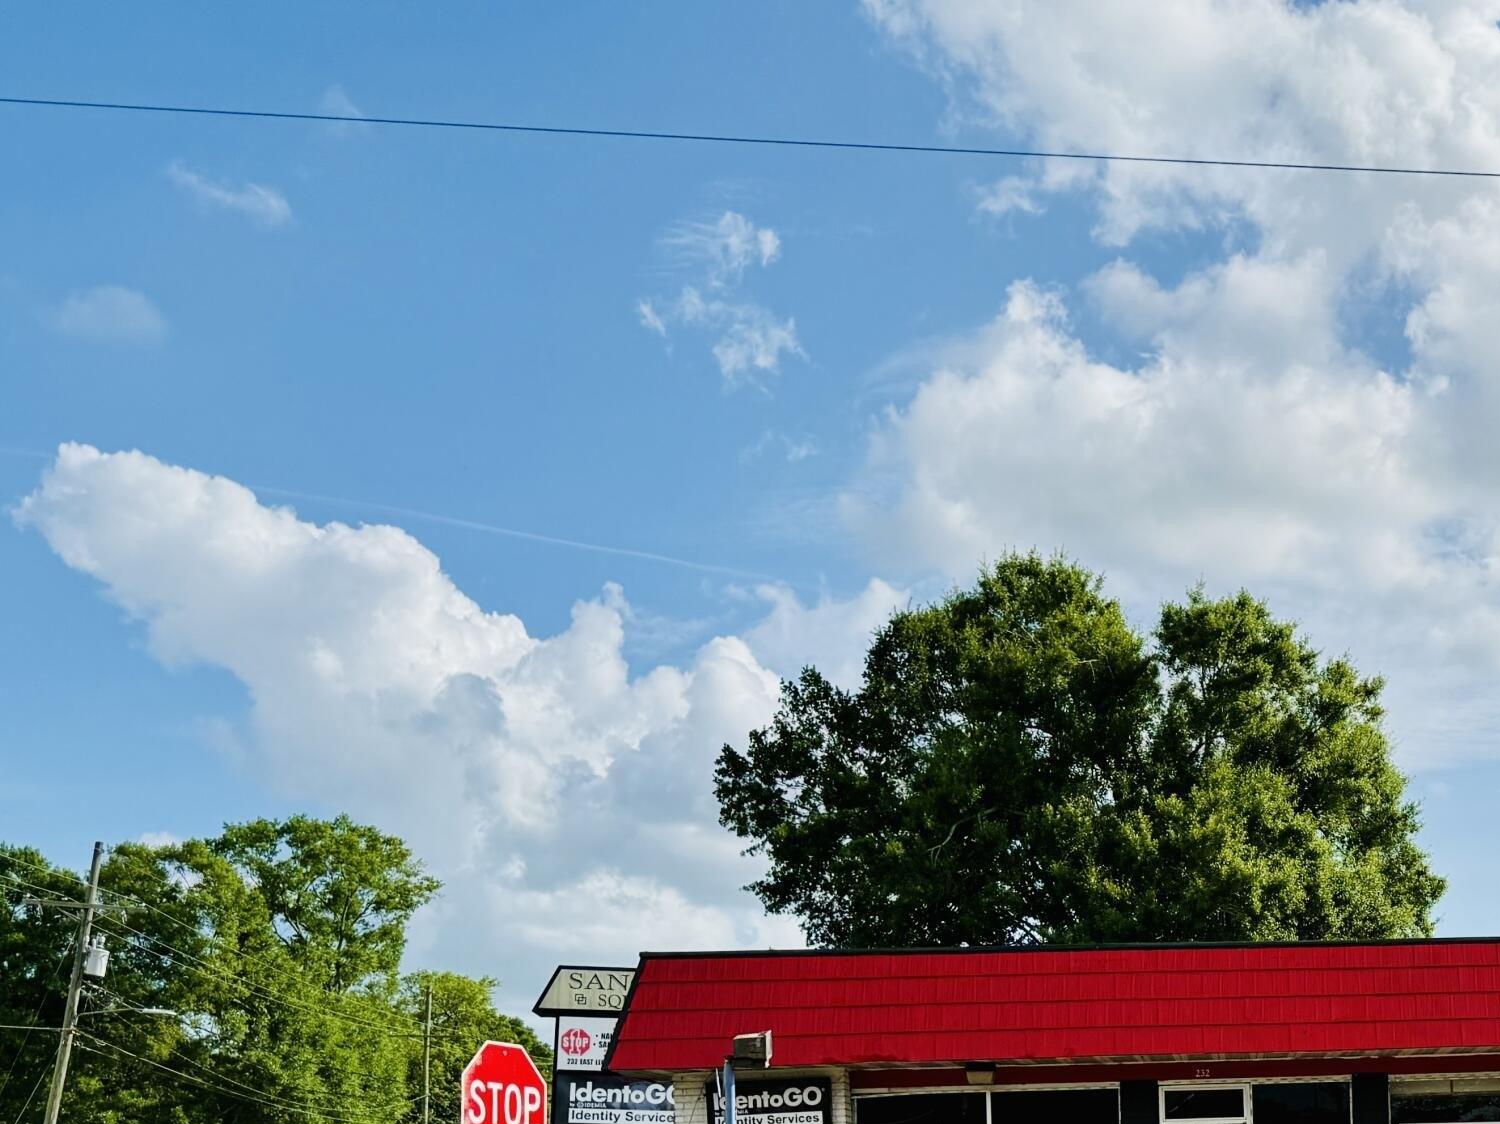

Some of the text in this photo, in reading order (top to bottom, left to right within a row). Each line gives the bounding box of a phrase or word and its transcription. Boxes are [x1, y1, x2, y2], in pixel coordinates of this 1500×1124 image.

[598, 994, 626, 1010] SQ
[1195, 1069, 1210, 1077] 232
[571, 1110, 620, 1123] Identity
[767, 1114, 820, 1124] Services
